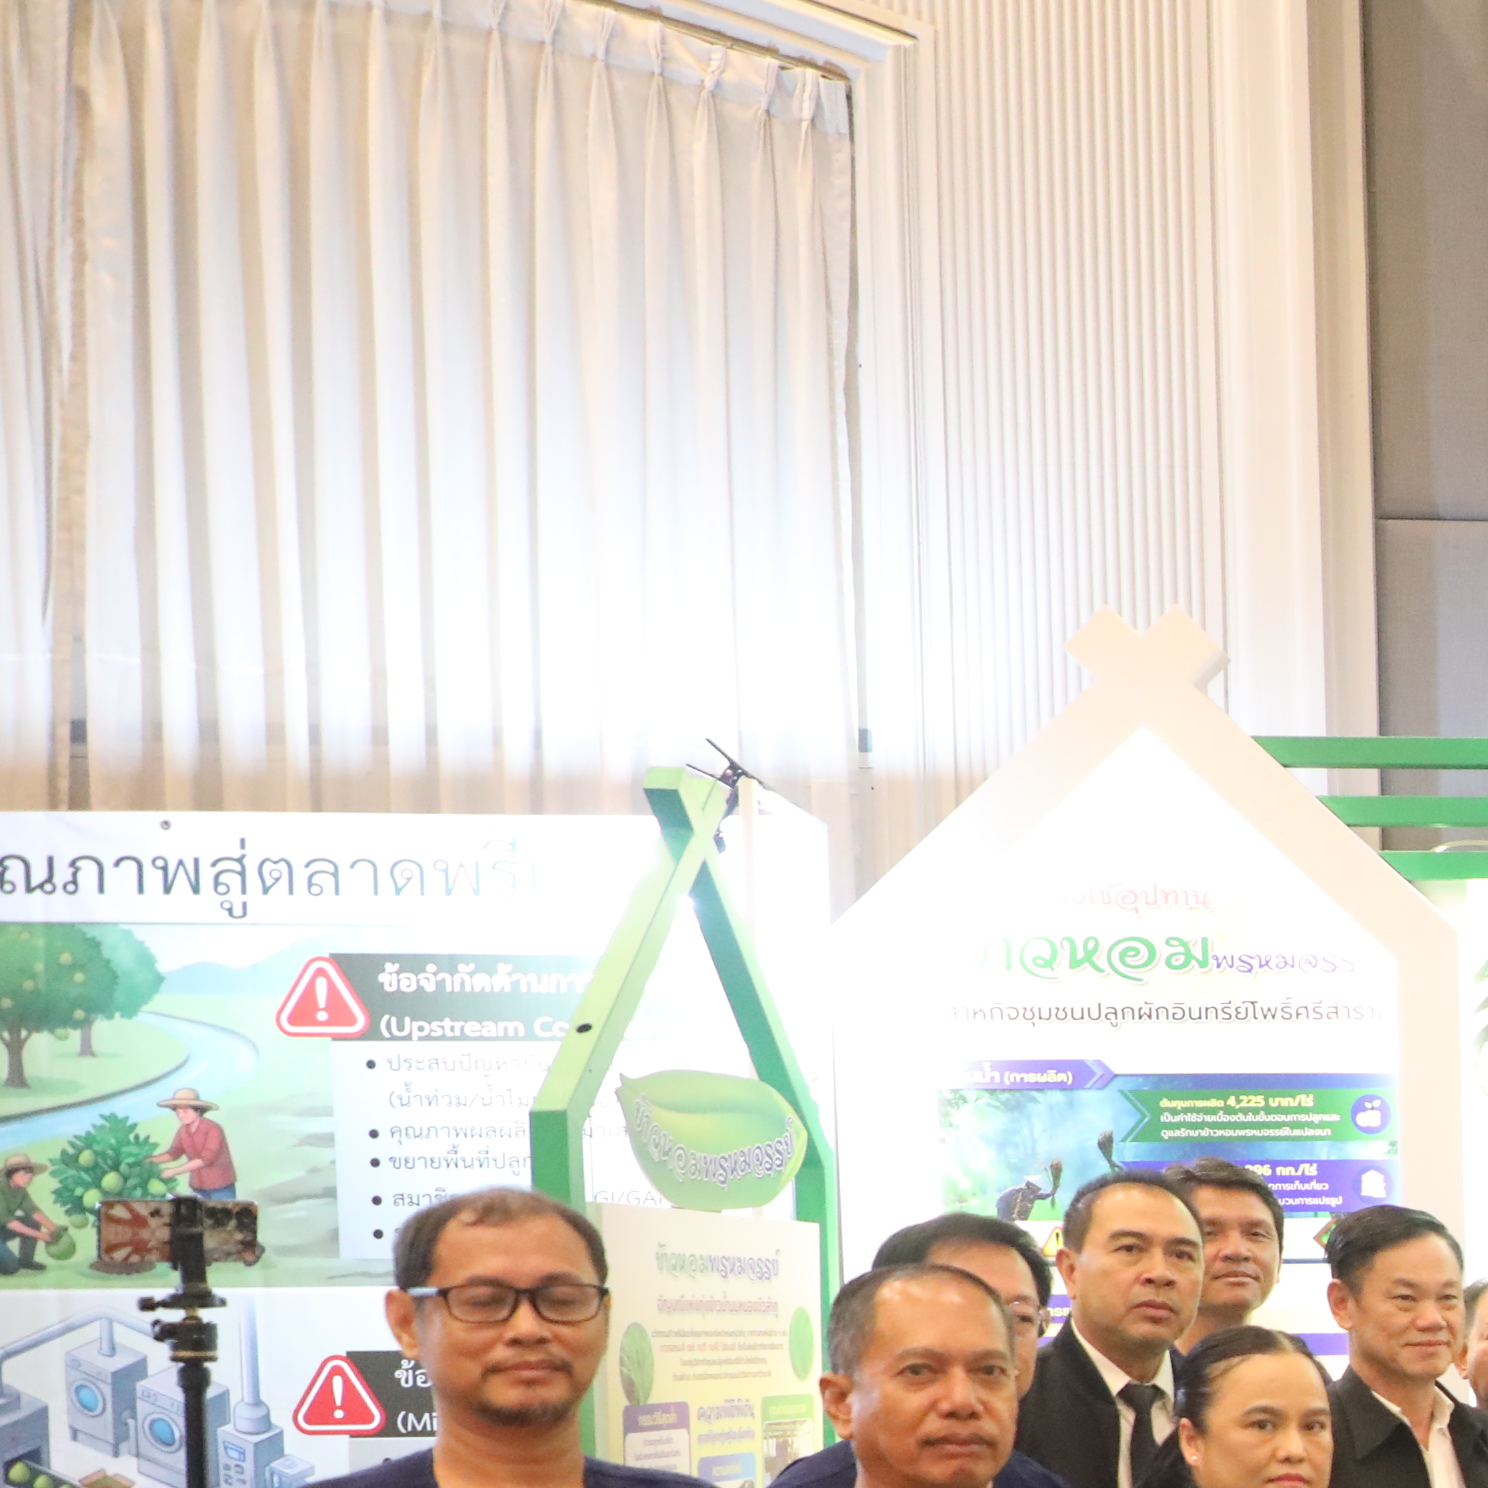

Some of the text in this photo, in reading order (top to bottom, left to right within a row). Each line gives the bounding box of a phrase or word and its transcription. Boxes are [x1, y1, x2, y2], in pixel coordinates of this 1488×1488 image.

[379, 1015, 526, 1041] (Upstream
[1004, 1069, 1074, 1085] (การผลิต)
[1226, 1094, 1265, 1109] 4,225
[1269, 1093, 1315, 1107] บาท/ไร่
[389, 1117, 527, 1146] คุณภาพผลผลิ
[1268, 1179, 1329, 1191] กการเก็บเกี่ยว
[1279, 1195, 1344, 1208] บวนการแปรรูป
[394, 1359, 433, 1388] ข้อ
[397, 1411, 438, 1433] (Mi
